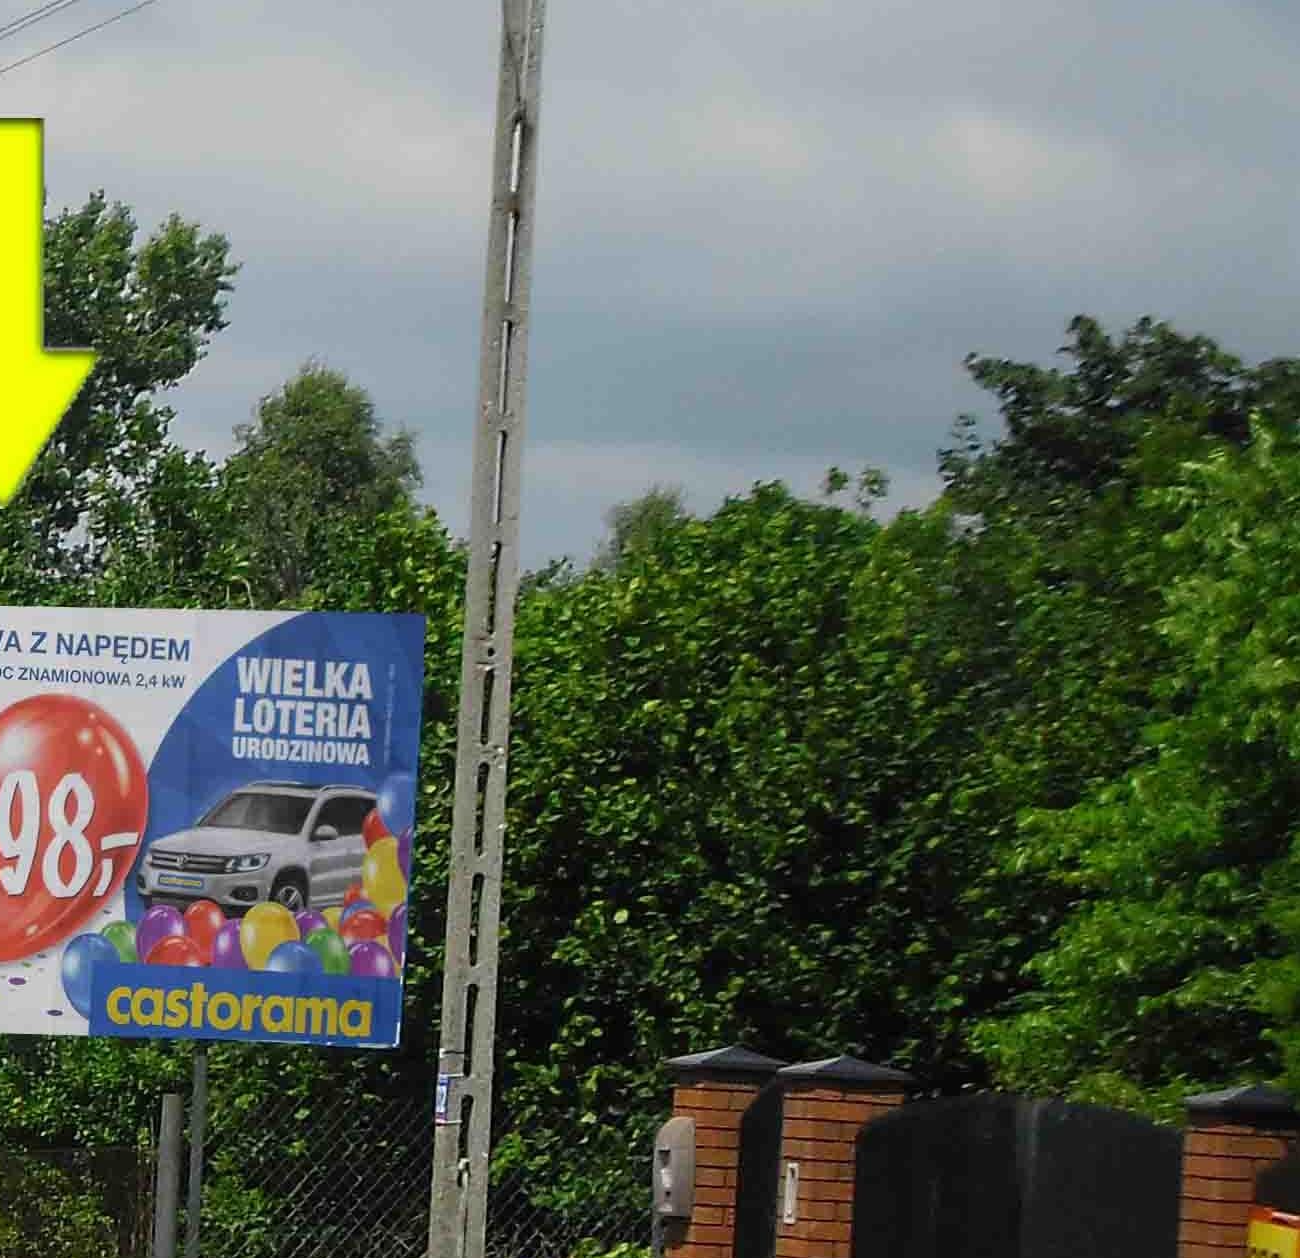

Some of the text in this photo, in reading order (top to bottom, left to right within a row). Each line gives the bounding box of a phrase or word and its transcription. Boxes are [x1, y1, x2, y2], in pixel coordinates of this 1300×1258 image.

[31, 631, 47, 654] Z
[55, 633, 191, 664] NAPĘDEM
[17, 667, 132, 686] ZNAMIONOWA
[135, 672, 160, 689] 2,4
[162, 673, 186, 689] kW
[236, 657, 373, 699] WIELKA
[233, 698, 371, 739] LOTERIA
[231, 736, 370, 765] URODZINOWA
[106, 982, 373, 1037] castorama
